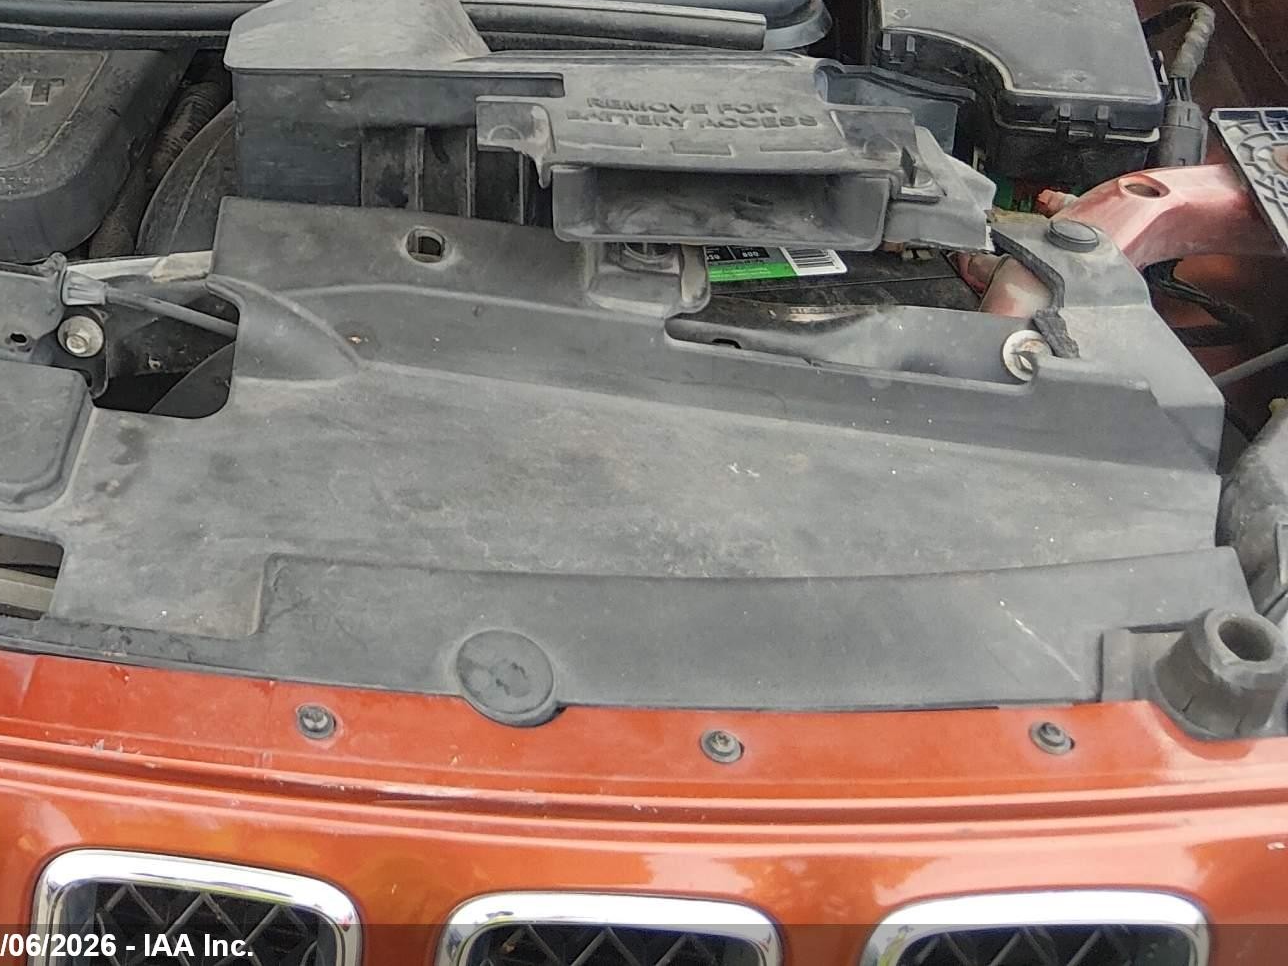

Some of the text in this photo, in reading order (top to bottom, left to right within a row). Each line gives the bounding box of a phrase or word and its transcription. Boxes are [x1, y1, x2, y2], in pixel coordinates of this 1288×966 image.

[586, 97, 779, 115] REMOVE FOR
[566, 110, 819, 130] BATTERY ACCESS
